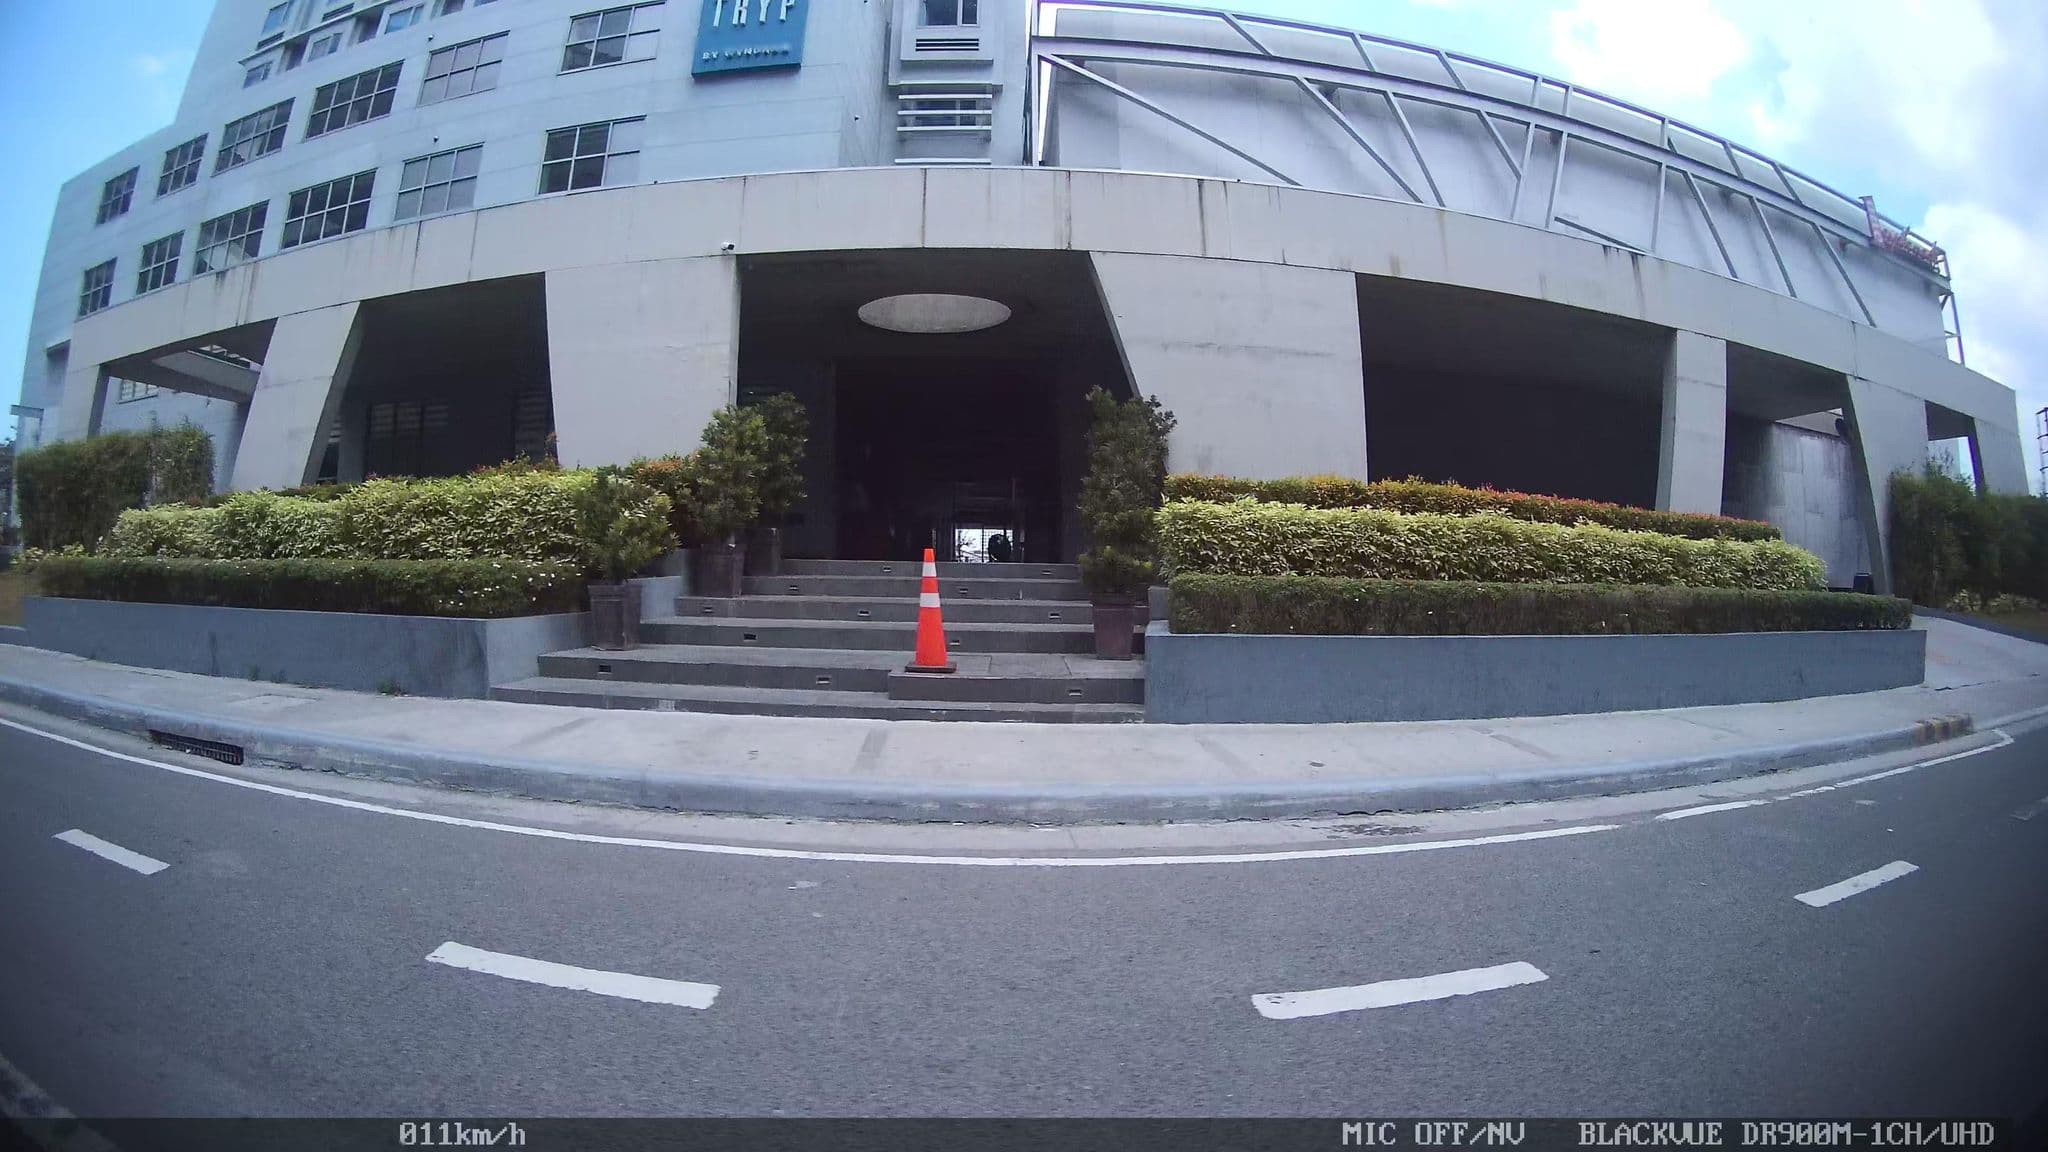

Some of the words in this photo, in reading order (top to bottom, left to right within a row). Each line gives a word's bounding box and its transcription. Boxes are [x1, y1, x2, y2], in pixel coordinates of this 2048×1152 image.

[713, 0, 796, 27] TRYP
[702, 51, 719, 60] BY
[724, 47, 789, 57] WYNDH
